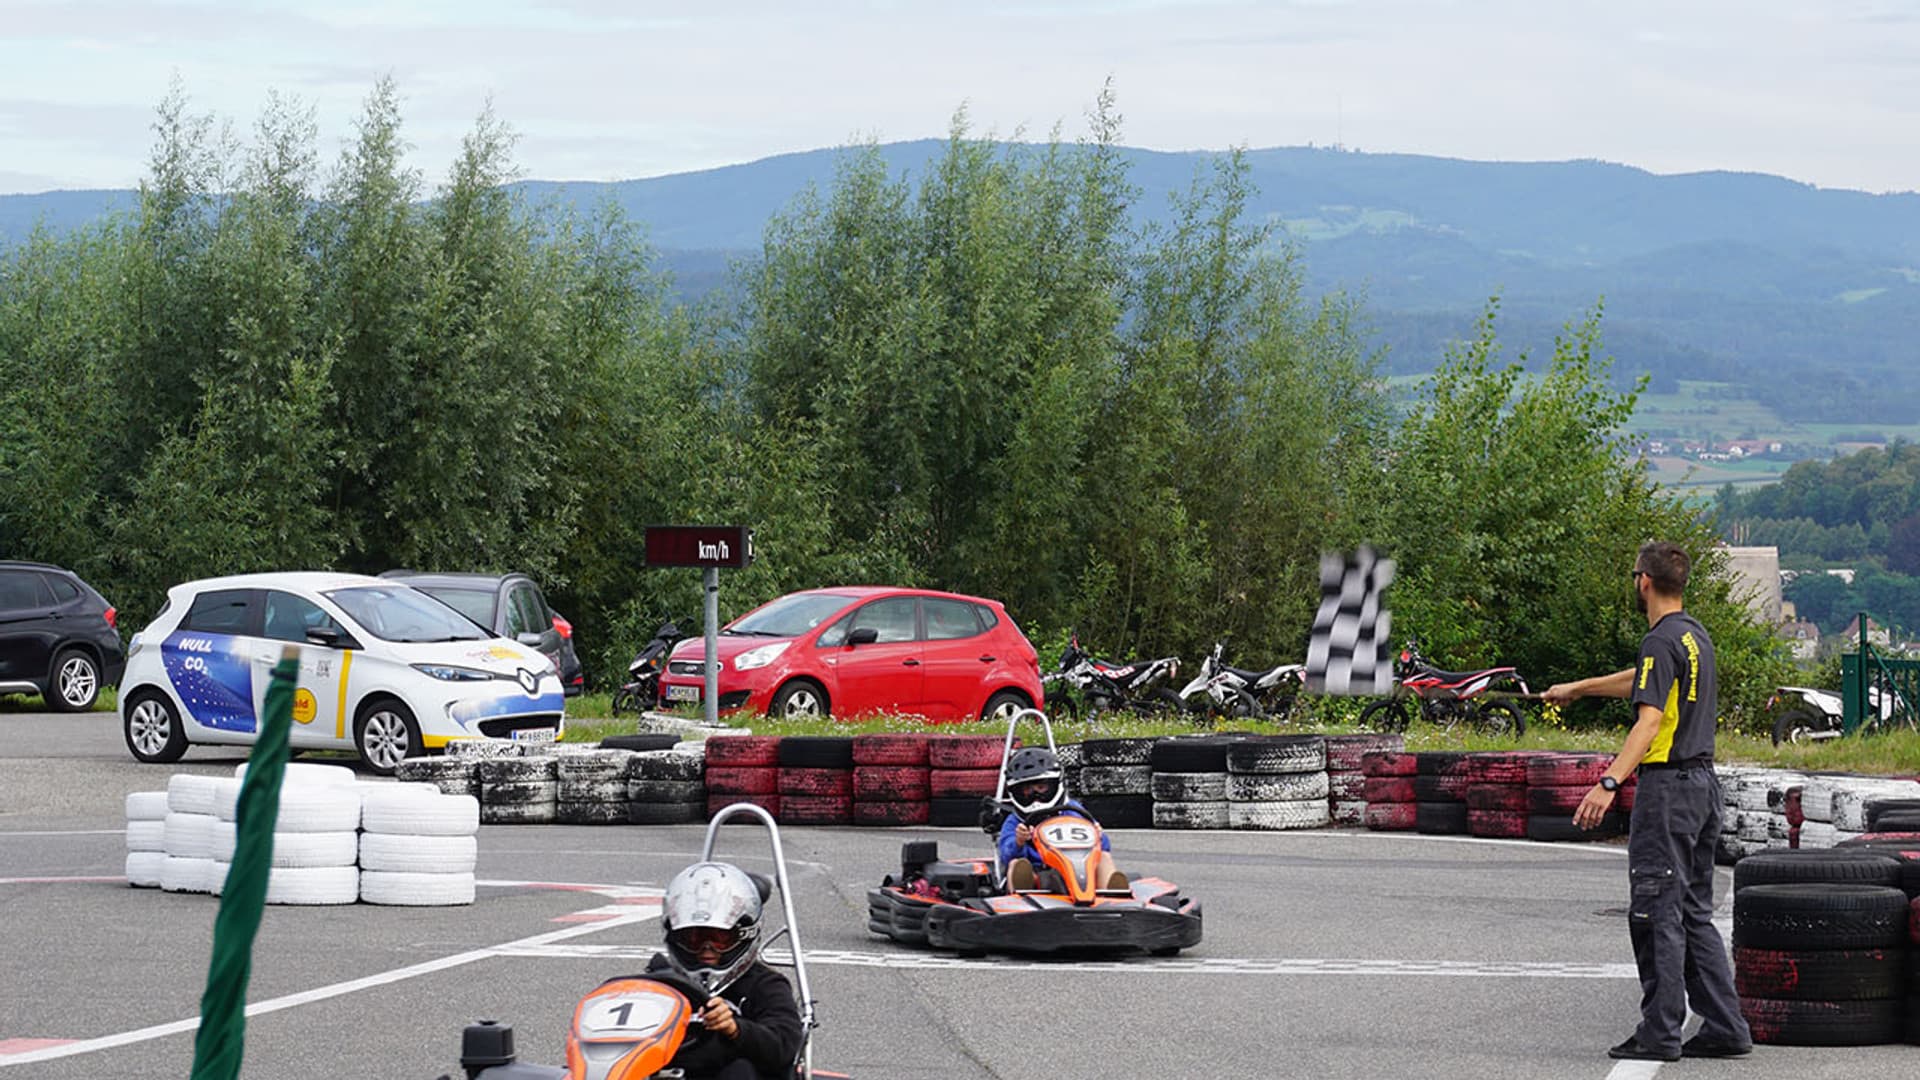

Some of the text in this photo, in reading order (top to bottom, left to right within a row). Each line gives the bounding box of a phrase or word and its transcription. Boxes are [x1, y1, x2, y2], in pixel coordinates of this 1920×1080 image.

[698, 540, 729, 561] km/h
[179, 638, 213, 652] NULL
[1048, 827, 1089, 841] 15
[608, 1002, 634, 1026] 1
